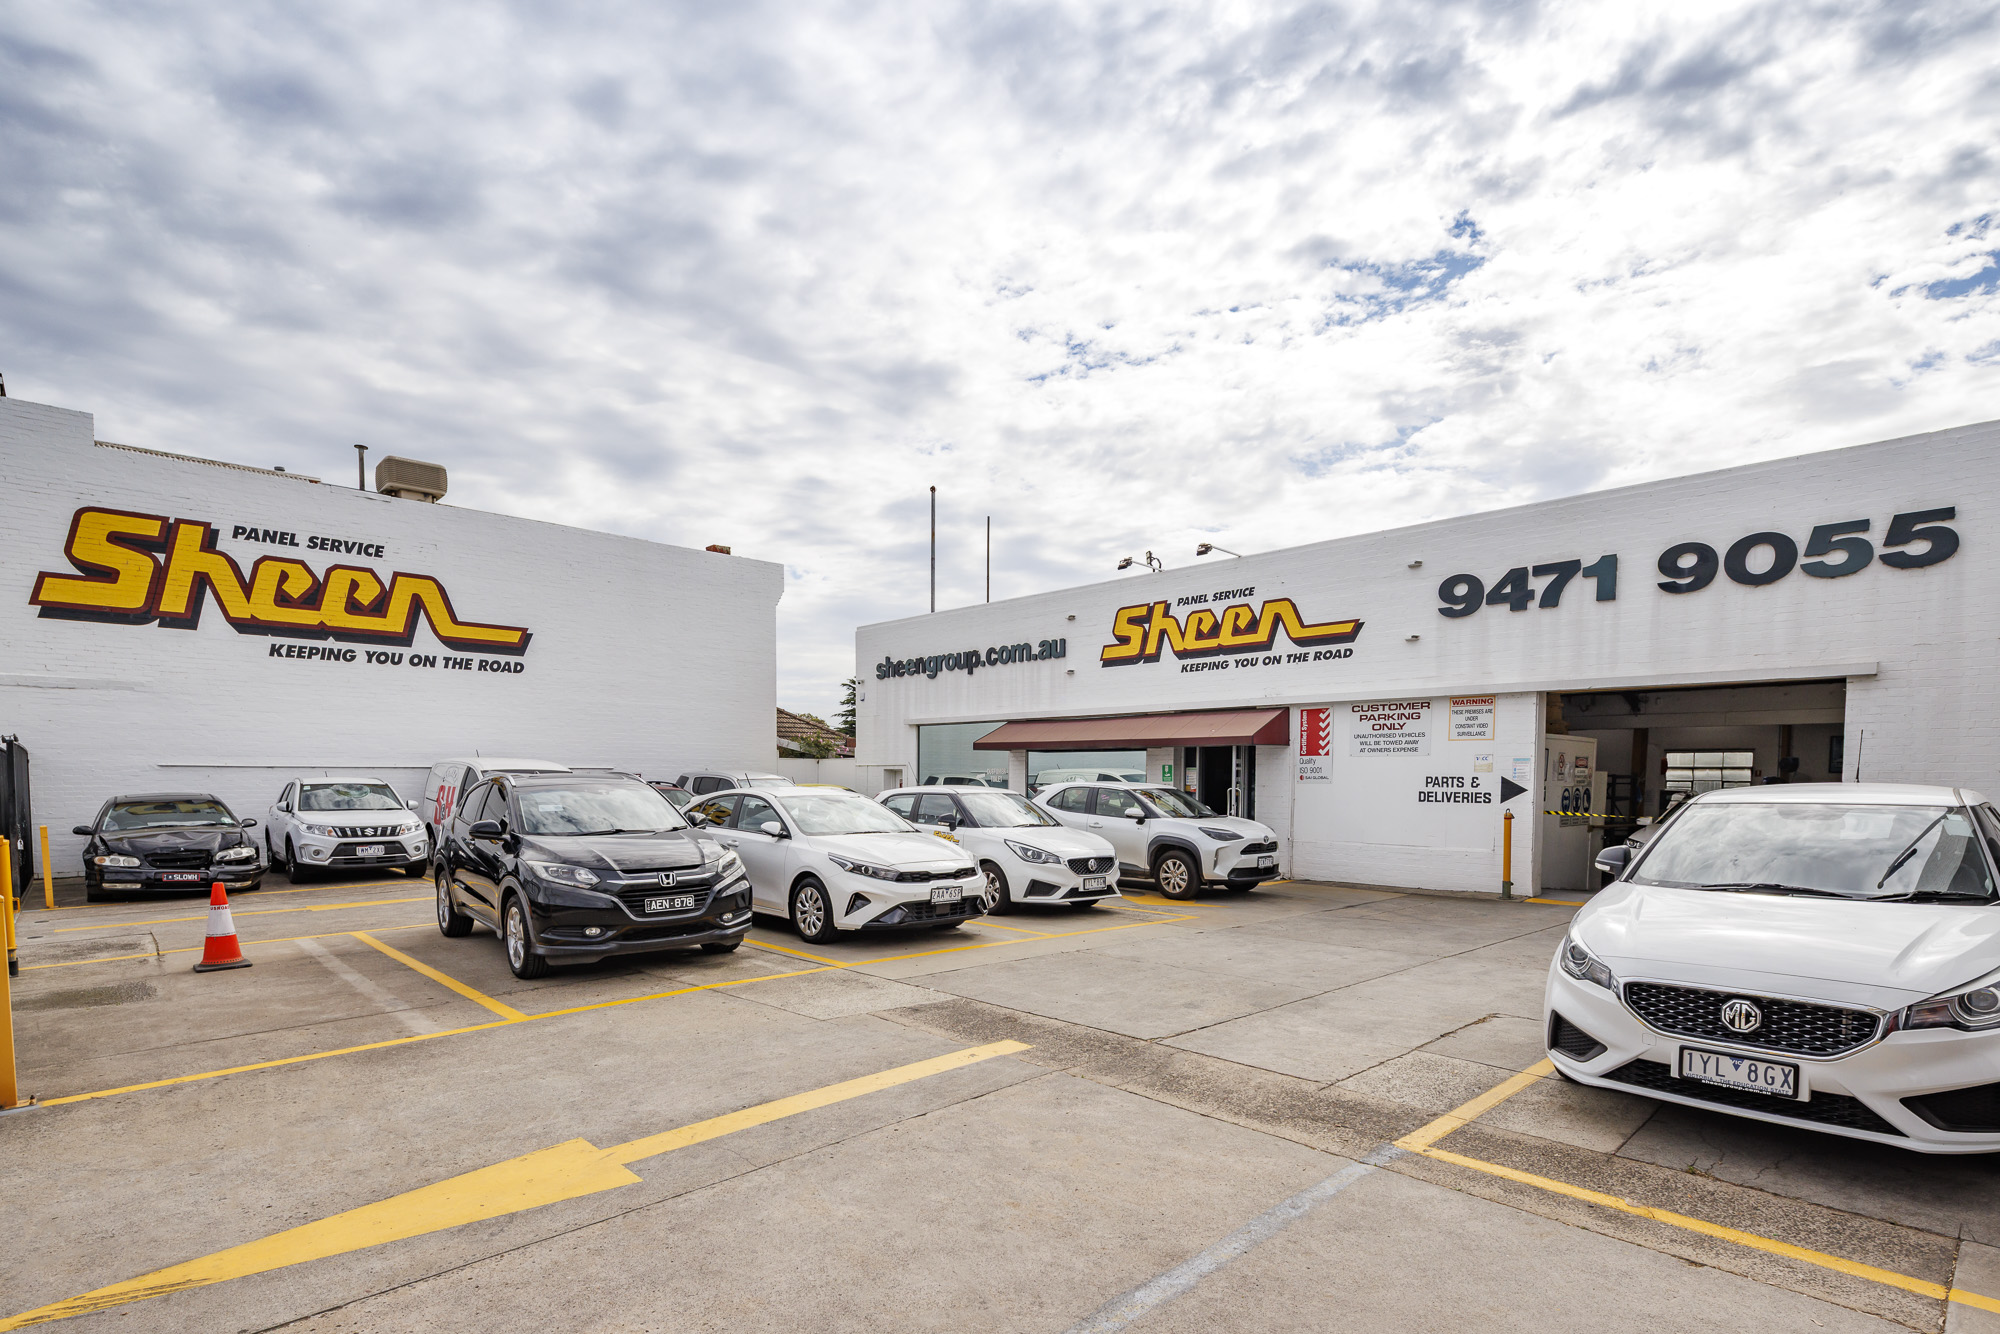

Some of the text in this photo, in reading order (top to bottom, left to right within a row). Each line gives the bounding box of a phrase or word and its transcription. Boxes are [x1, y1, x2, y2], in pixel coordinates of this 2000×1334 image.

[232, 525, 385, 558] PANEL SERVICE
[1437, 506, 1961, 618] 9471 9055
[29, 506, 533, 656] Sheen
[1177, 586, 1255, 607] PANEL SERVICE
[1100, 597, 1365, 668] Sheen
[268, 643, 525, 674] KEEPING YOU ON THE ROAD
[876, 638, 1067, 680] sheengroup.com.au
[1181, 648, 1353, 673] KEEPING YOU ON THE ROAD
[1351, 701, 1431, 713] CUSTOMER
[1359, 712, 1421, 722] PARKING
[1372, 722, 1407, 731] ONLY
[1299, 757, 1316, 766] Quality
[1425, 776, 1480, 788] PARTS &
[1418, 791, 1492, 804] DELIVERIES
[1724, 1002, 1758, 1031] MG
[1687, 1052, 1793, 1090] 1YL 8GX
[1685, 1072, 1714, 1081] VICTORIA
[1733, 1080, 1769, 1092] EDUCATION
[1771, 1087, 1790, 1096] STATE
